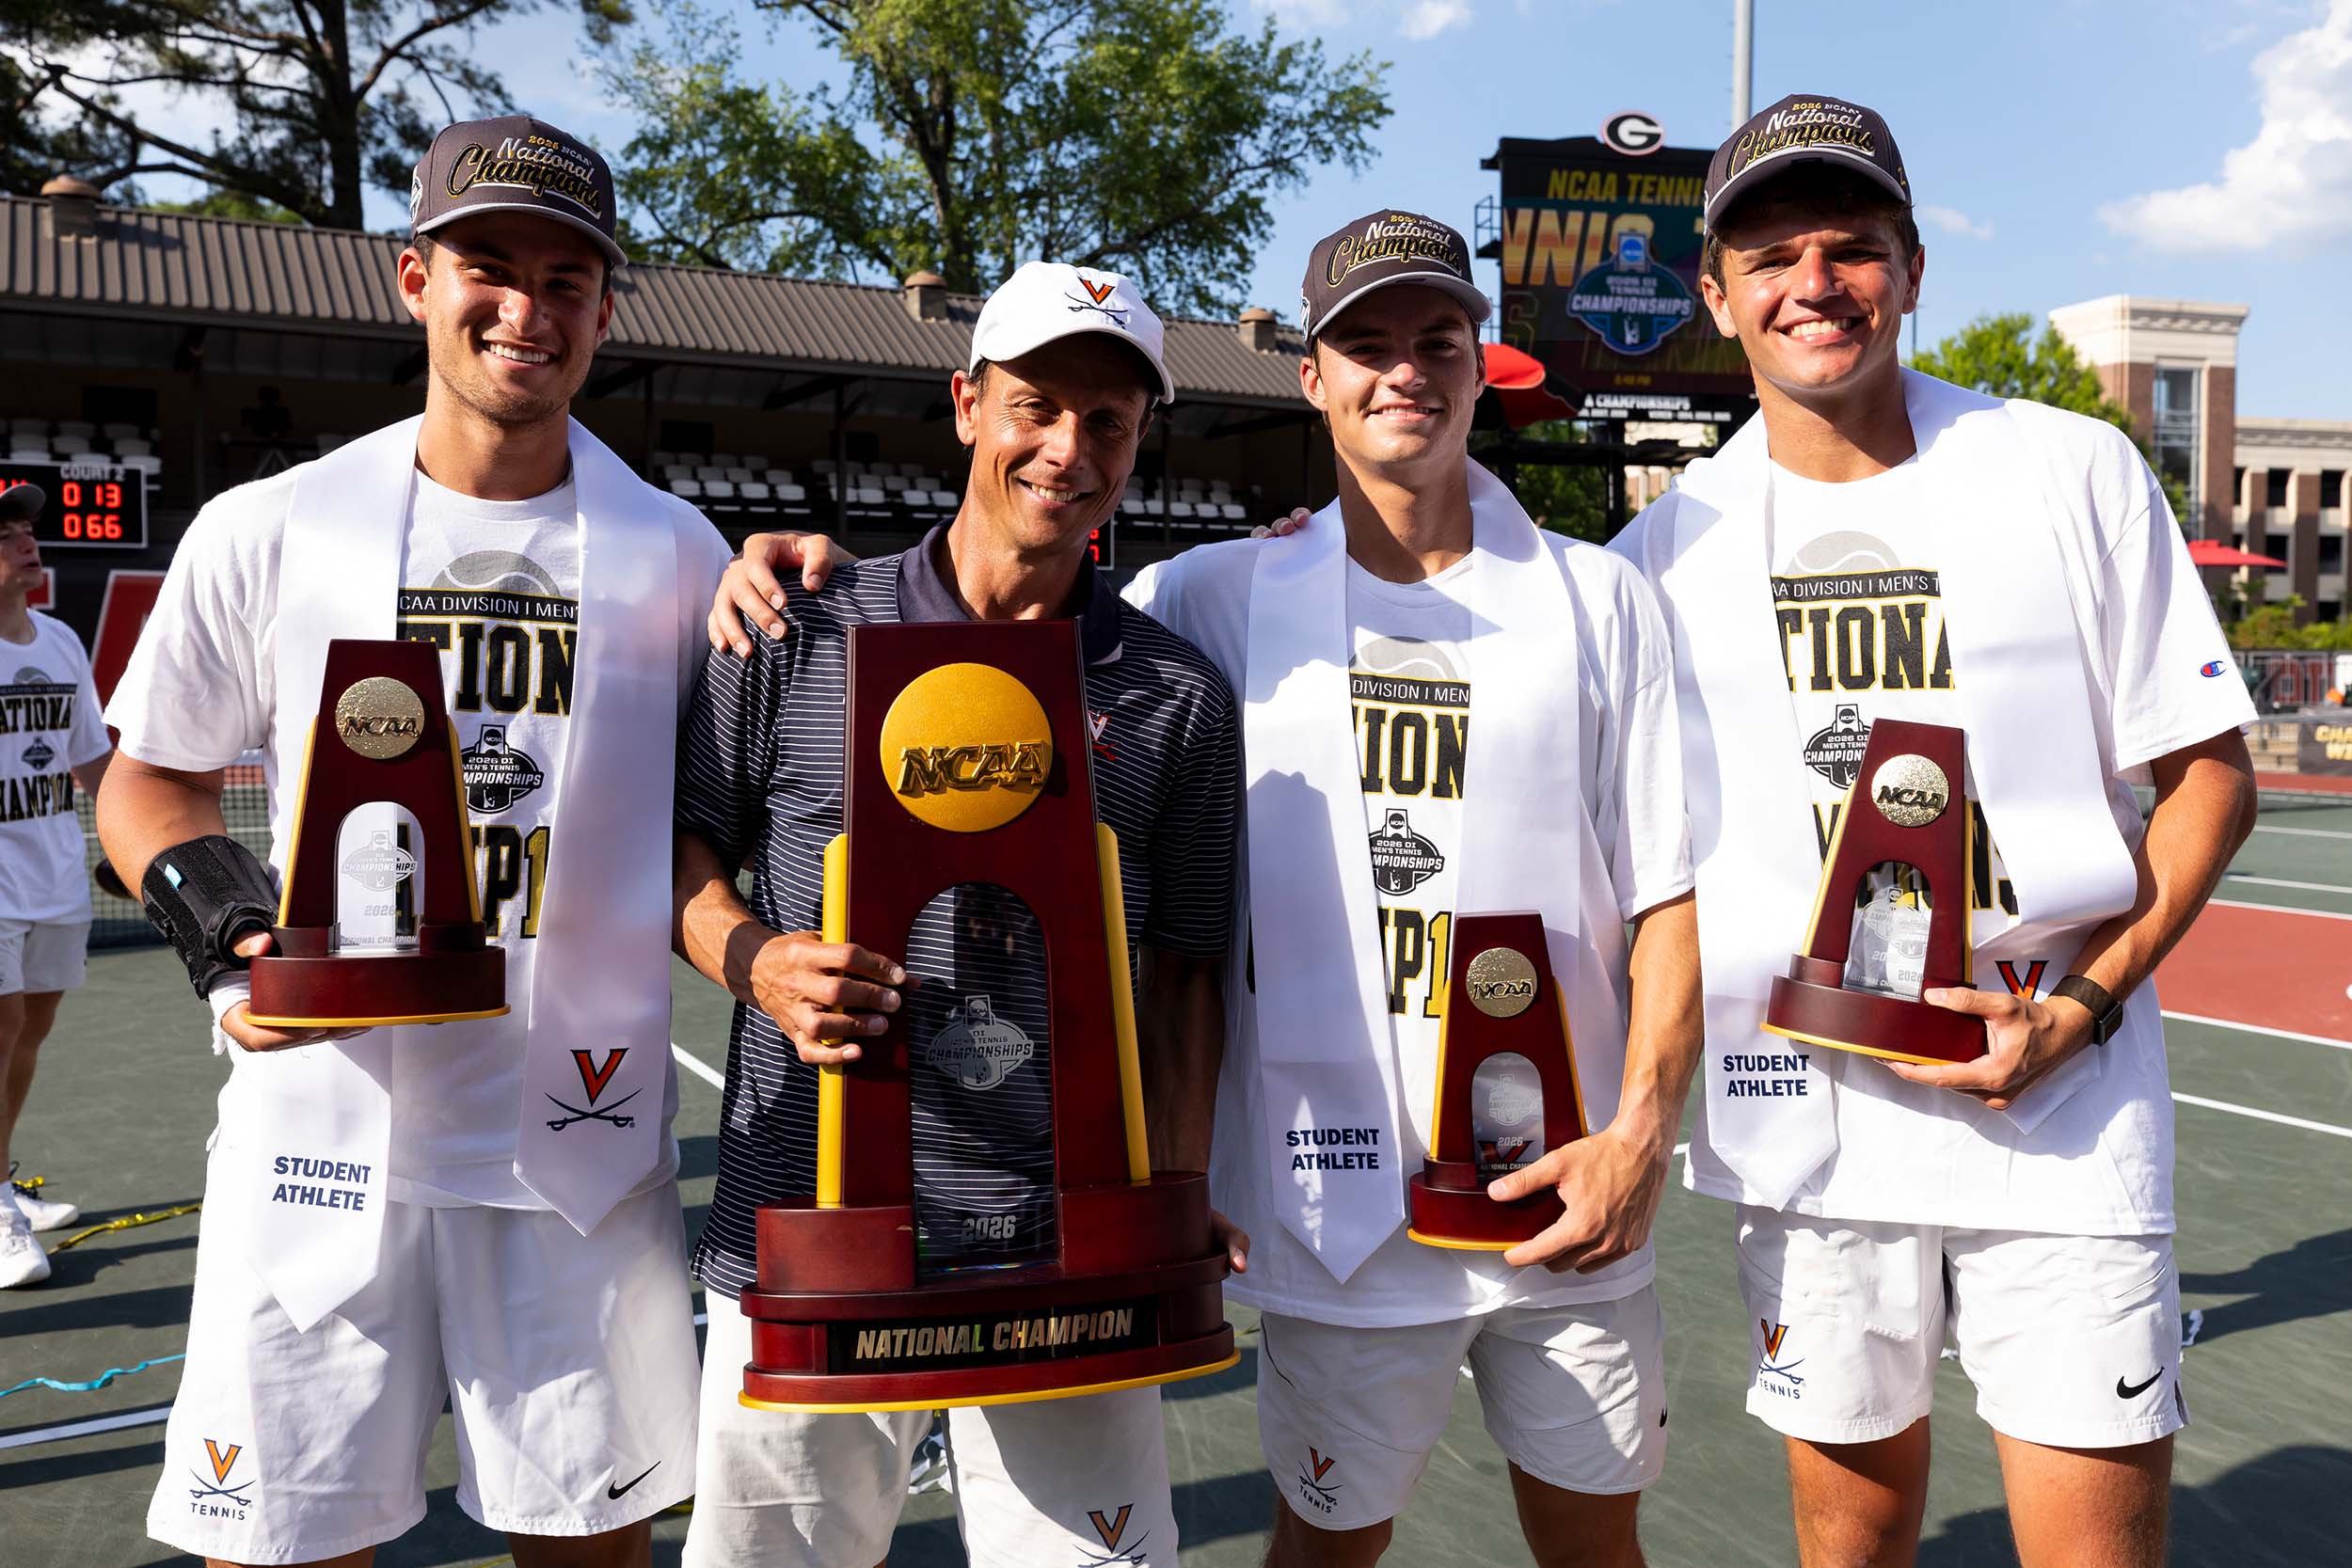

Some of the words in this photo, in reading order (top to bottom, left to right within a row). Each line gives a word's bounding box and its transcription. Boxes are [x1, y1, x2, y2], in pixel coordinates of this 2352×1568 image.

[1792, 102, 1822, 111] 2026
[1766, 108, 1863, 135] National
[497, 136, 596, 185] National
[1726, 123, 1876, 181] Champions
[446, 142, 602, 214] Champions
[1547, 168, 1618, 203] NCAA
[1365, 220, 1451, 247] National
[1327, 235, 1462, 289] Champions
[1077, 277, 1116, 306] V
[1572, 293, 1692, 316] CHAMPIONSHIPS
[60, 465, 111, 481] COURT
[114, 467, 125, 482] 2
[1793, 579, 1862, 597] DIVISION
[1879, 575, 1929, 593] MEN'S
[399, 595, 436, 610] CAA
[442, 596, 519, 614] DIVISION
[1353, 679, 1420, 700] DIVISION
[1434, 688, 1470, 703] MEN
[343, 713, 420, 737] NCAA
[1352, 706, 1470, 800] ION
[898, 740, 1049, 794] NCAA
[1877, 784, 1945, 811] NCAA
[1472, 977, 1534, 1000] NCAA
[1994, 960, 2050, 1002] V
[928, 1043, 1031, 1062] CHAMPIONSHIPS
[978, 1036, 1009, 1044] TENNIS
[1723, 1054, 1810, 1072] STUDENT
[570, 1048, 630, 1107] V
[1727, 1079, 1808, 1097] ATHLETE
[1286, 1128, 1380, 1147] STUDENT
[1497, 1136, 1524, 1147] 2026
[273, 1156, 372, 1184] STUDENT
[1291, 1152, 1379, 1171] ATHLETE
[272, 1183, 366, 1212] ATHLETE
[962, 1215, 1017, 1241] 2026
[855, 1323, 985, 1360] NATIONAL
[993, 1307, 1134, 1352] CHAMPION
[1760, 1318, 1790, 1364] V
[203, 1437, 244, 1486] V
[1308, 1444, 1336, 1483] V
[190, 1502, 246, 1520] TENNIS
[1299, 1484, 1332, 1513] TENNIS
[1086, 1503, 1135, 1555] V
